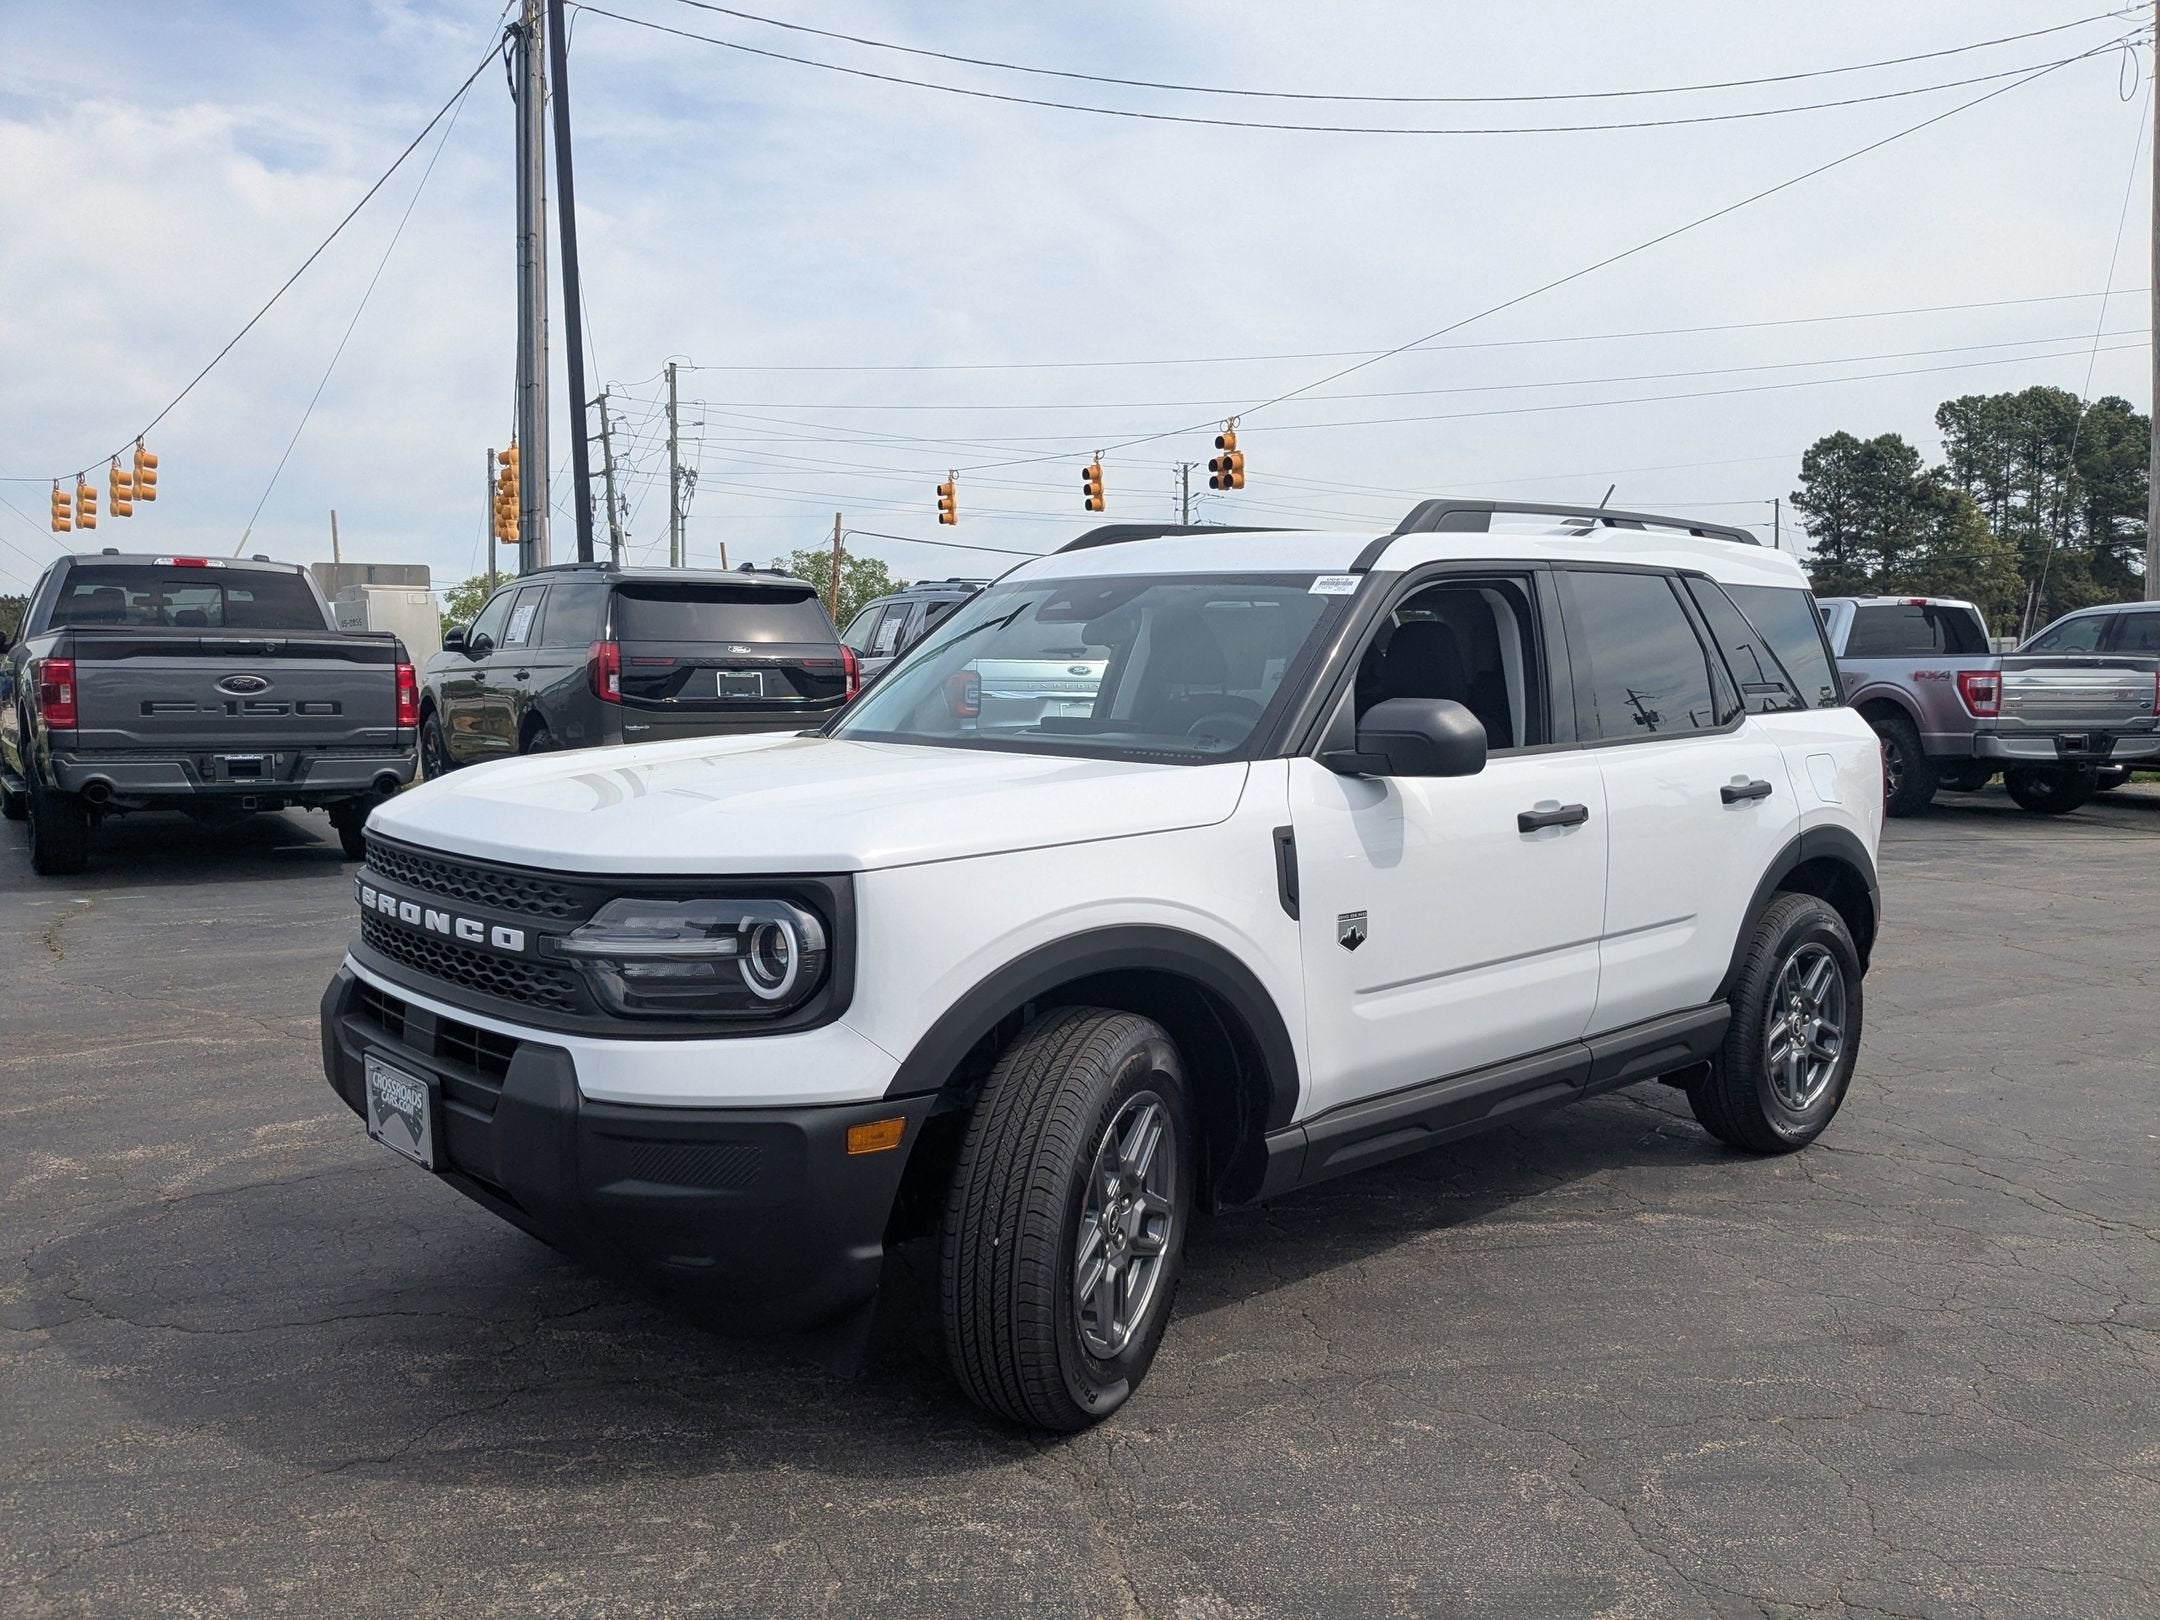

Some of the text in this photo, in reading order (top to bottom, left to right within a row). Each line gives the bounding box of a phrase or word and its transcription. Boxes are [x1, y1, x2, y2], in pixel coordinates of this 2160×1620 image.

[1913, 670, 1951, 681] FX4
[138, 699, 345, 718] F-150
[361, 885, 525, 952] BRONCO
[372, 1071, 423, 1109] CROSSROADS
[381, 1090, 414, 1116] CARS.COM
